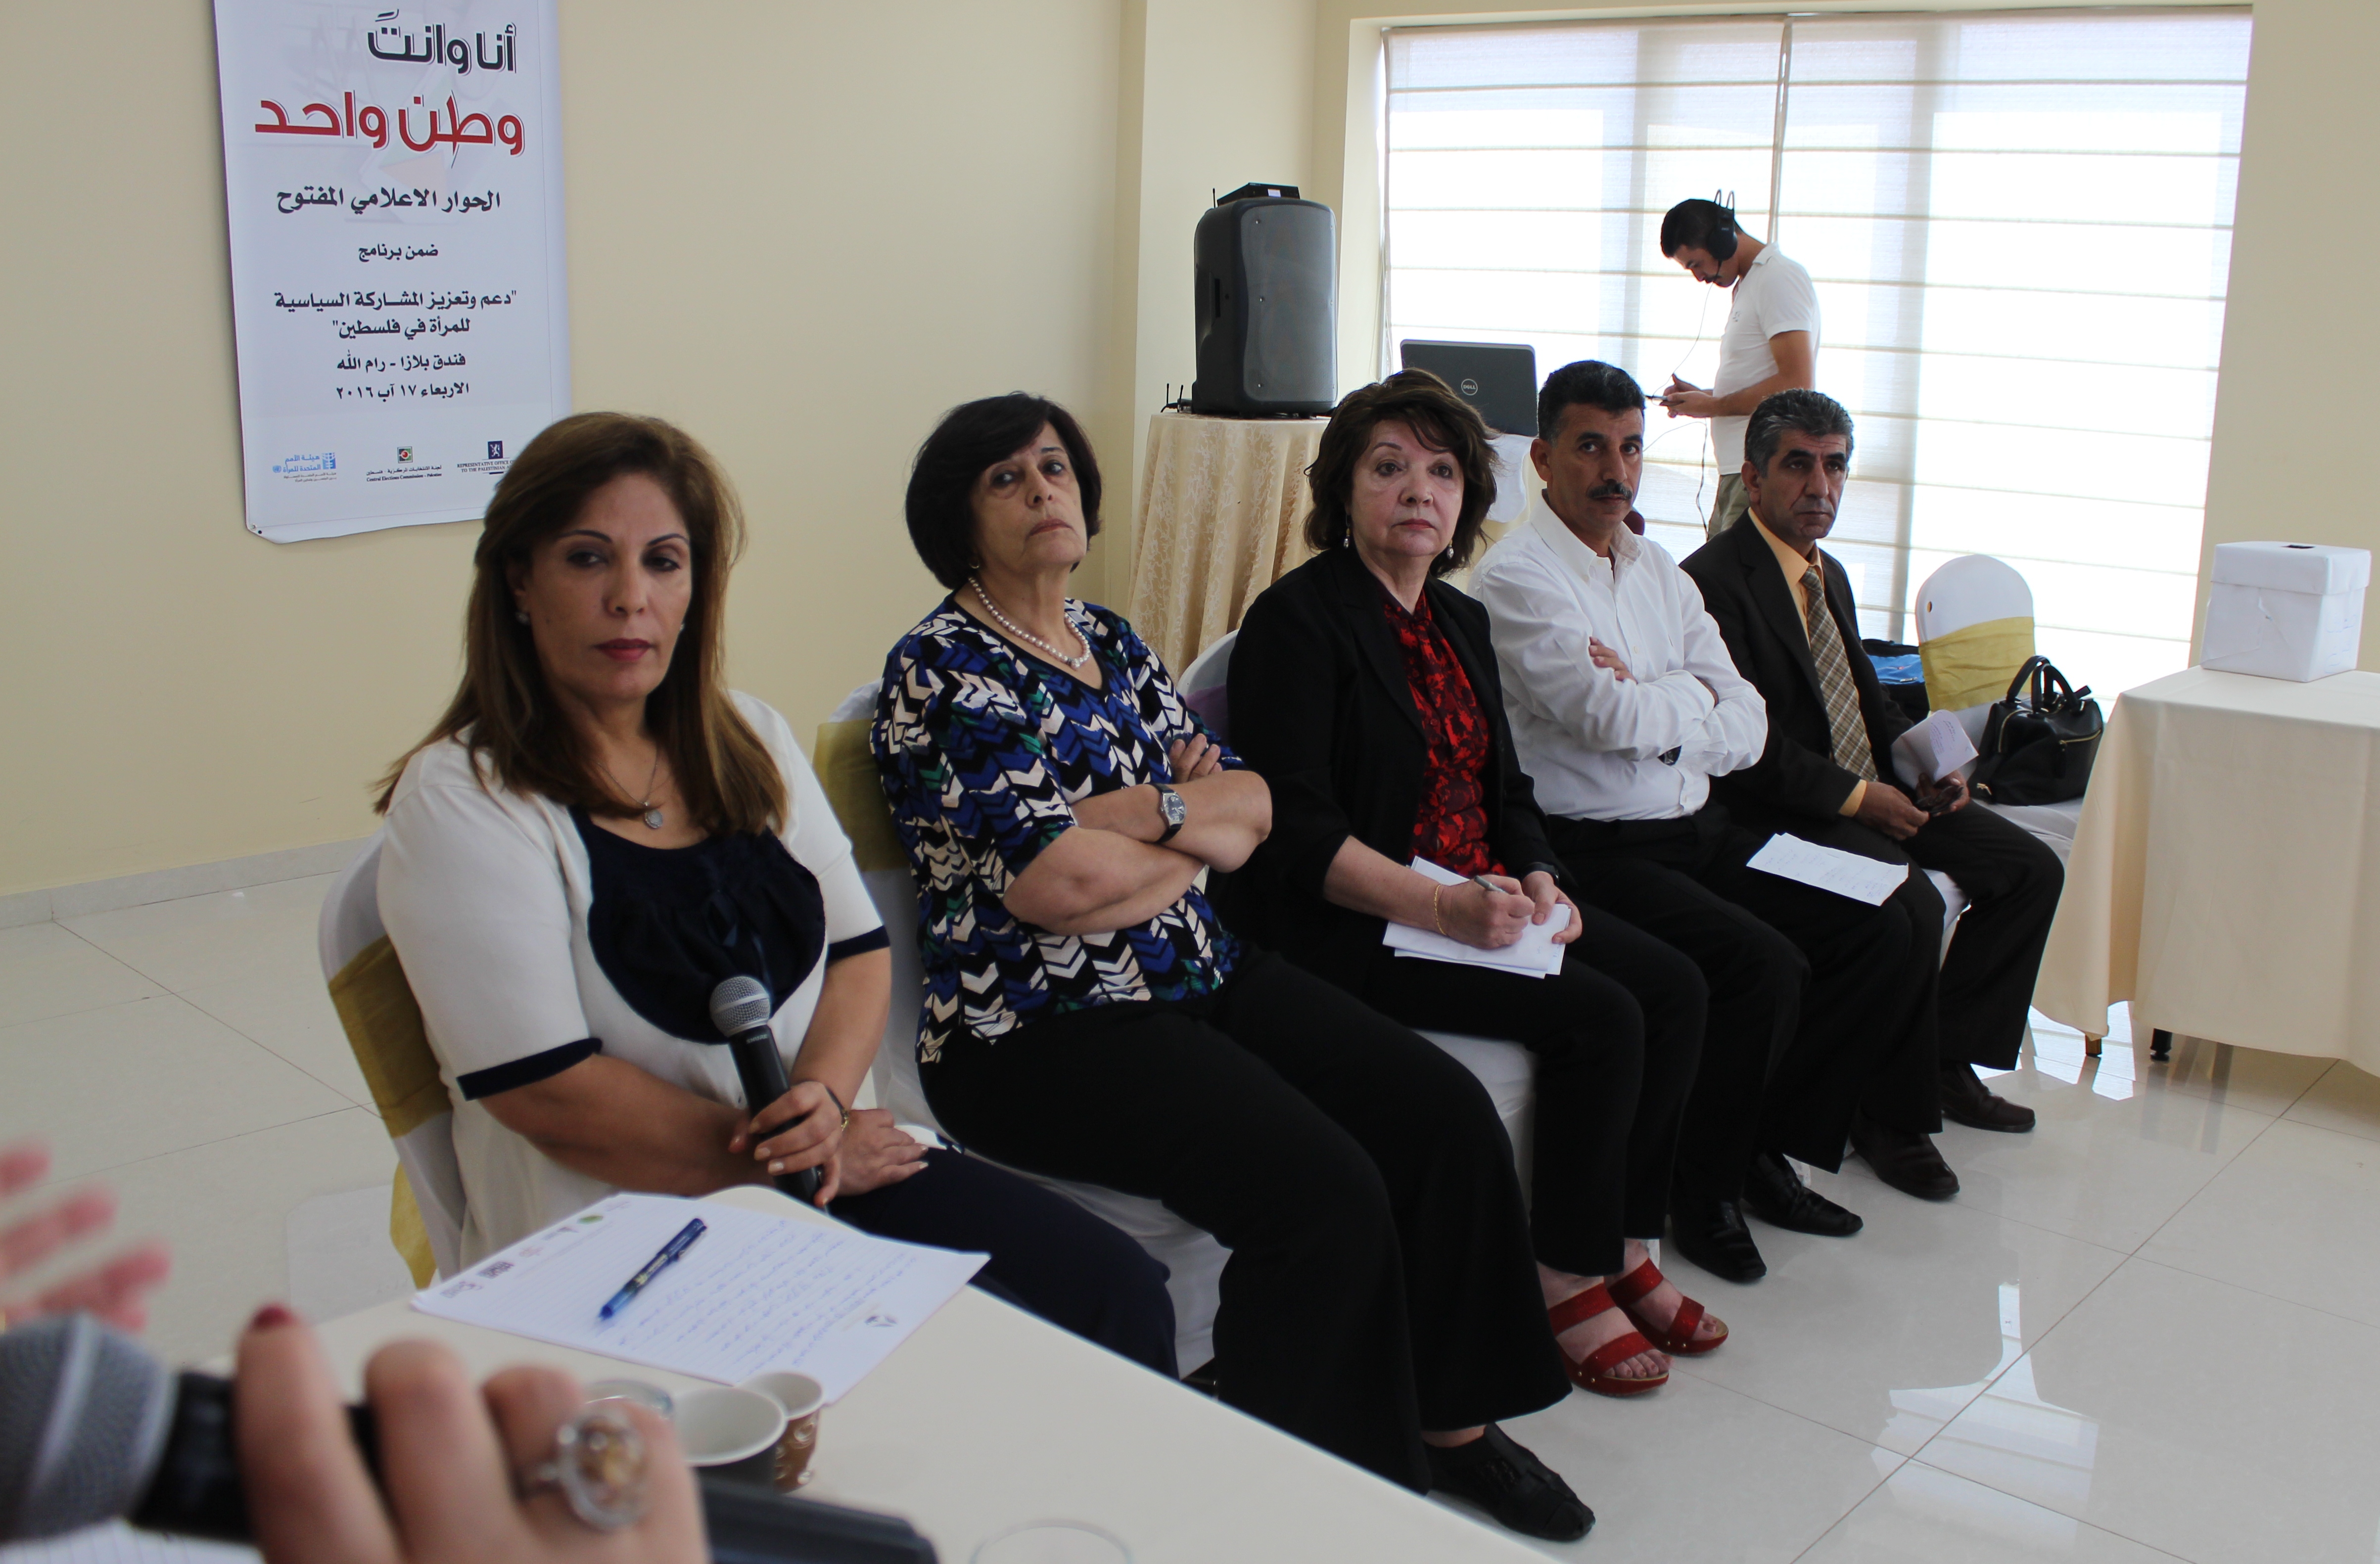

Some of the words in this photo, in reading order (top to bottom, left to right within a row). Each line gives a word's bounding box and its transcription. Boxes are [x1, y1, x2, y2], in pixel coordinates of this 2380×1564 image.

[476, 23, 516, 73] أنا
[255, 90, 389, 148] واحد
[398, 93, 525, 161] وطن
[277, 185, 344, 214] المفتوح
[351, 186, 437, 215] الاعلامي
[441, 190, 500, 213] الحوار
[358, 243, 402, 263] برنامج
[405, 244, 438, 261] ضمن
[274, 292, 350, 313] السياسية
[425, 290, 476, 311] وتعزيز
[404, 318, 426, 340] في
[429, 316, 470, 337] للمرأة
[337, 349, 361, 370] الله
[365, 357, 386, 374] رام
[401, 355, 429, 371] بلازا
[433, 353, 466, 371] فندق
[336, 386, 373, 400] ٢٠١٦
[377, 383, 395, 403] آب
[400, 384, 417, 397] ١٧
[420, 381, 469, 400] الاربعاء
